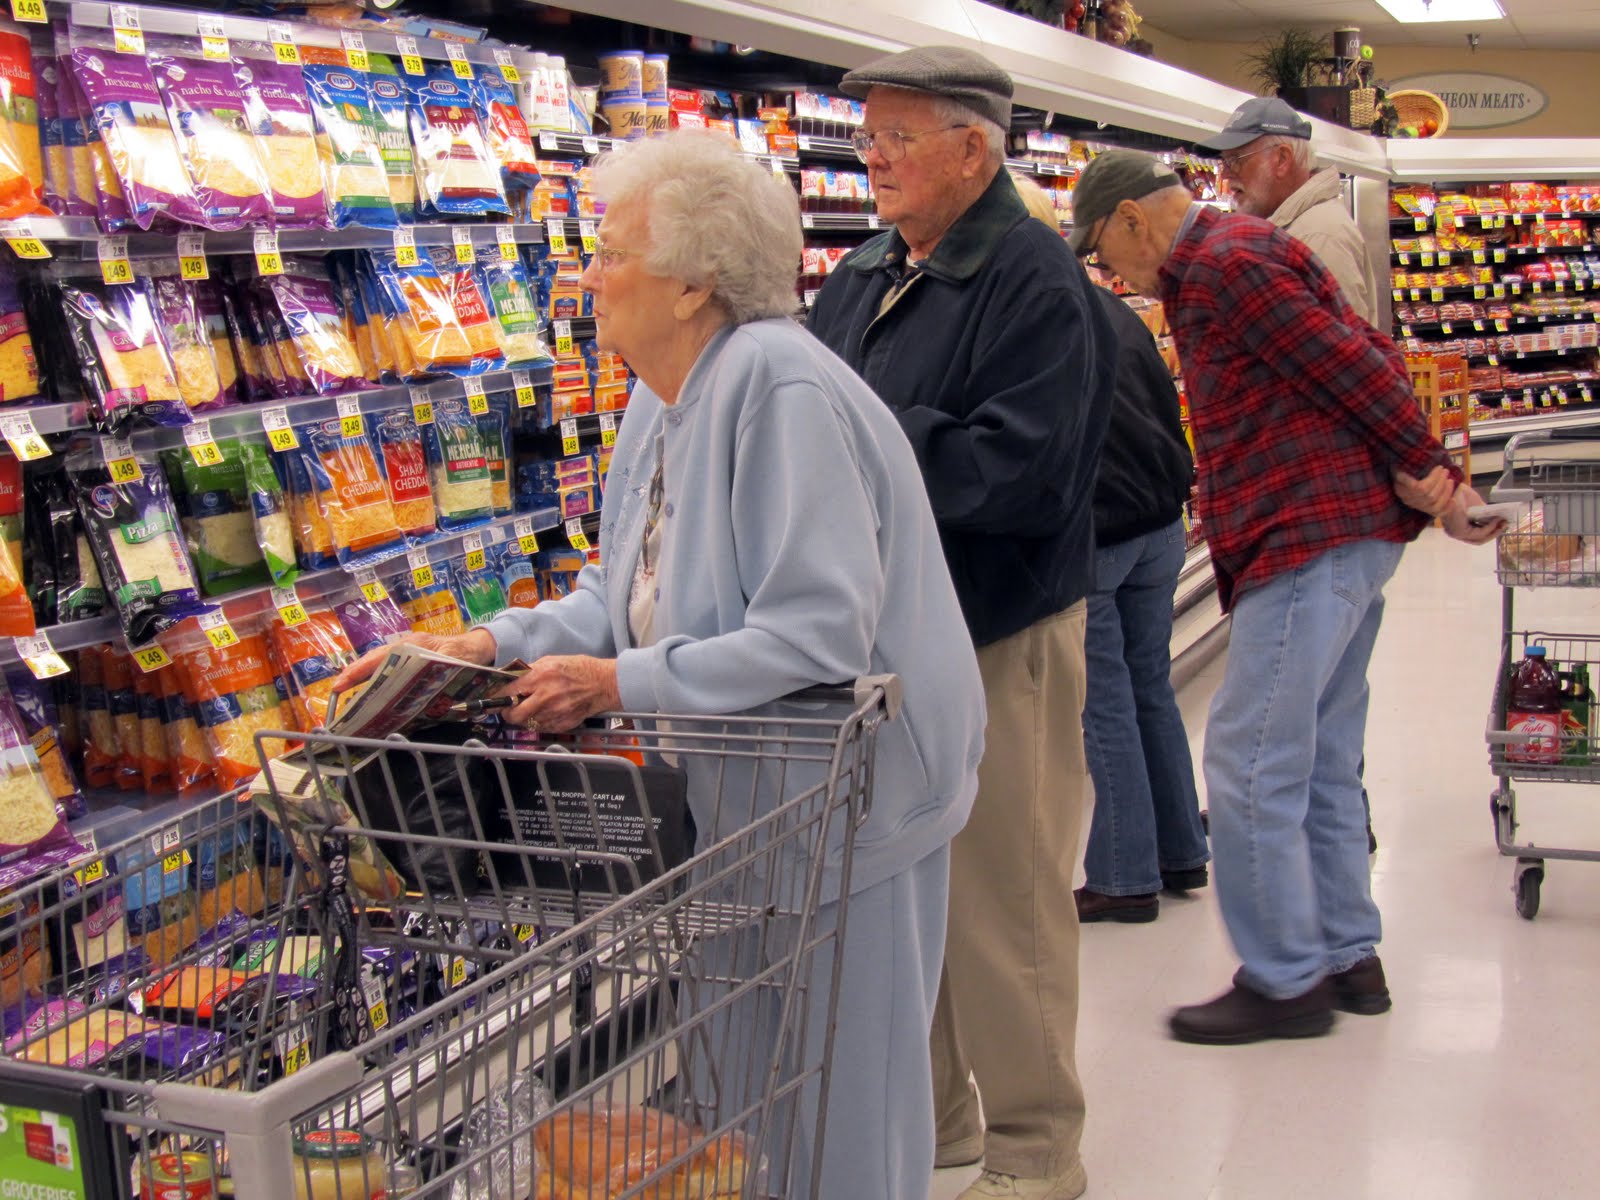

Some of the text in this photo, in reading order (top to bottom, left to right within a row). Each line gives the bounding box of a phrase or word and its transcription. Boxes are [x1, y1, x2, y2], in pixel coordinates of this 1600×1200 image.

[19, 2, 41, 15] 4.49
[279, 48, 296, 59] 4.49
[350, 54, 366, 66] 5.79
[405, 59, 421, 71] 5.79
[455, 64, 469, 75] 3.49
[0, 64, 31, 80] heddar
[505, 69, 518, 79] 3.49
[104, 78, 142, 89] mexican
[180, 83, 212, 96] nacho
[212, 84, 223, 97] &
[434, 83, 454, 92] KRAFT
[1436, 92, 1524, 109] HEON MEATS
[16, 243, 40, 253] 1.49
[552, 239, 564, 249] 3.49
[400, 250, 414, 261] 3.49
[458, 249, 472, 259] 3.49
[185, 261, 202, 274] 1.49
[262, 257, 278, 270] 1.49
[107, 264, 126, 278] 1.49
[455, 293, 473, 307] ARP
[457, 302, 484, 319] DDAR
[559, 340, 570, 351] 3.49
[519, 391, 532, 402] 3.49
[471, 398, 485, 410] 3.49
[417, 408, 431, 420] 3.49
[344, 420, 360, 433] 3.49
[273, 433, 291, 446] 1.49
[565, 440, 576, 450] 3.49
[196, 447, 215, 460] 1.49
[447, 442, 481, 460] MEXICAN
[115, 463, 135, 477] 1.49
[399, 464, 424, 477] SHARP
[455, 460, 479, 469] AUTHENTIC
[342, 481, 382, 498] CHEDDAR
[127, 521, 158, 540] Pizza
[522, 539, 535, 551] 3.49
[572, 537, 586, 548] 3.49
[469, 554, 482, 567] 3.49
[416, 571, 431, 583] 3.49
[284, 608, 302, 622] 1.49
[422, 614, 452, 631] TRIPLE
[212, 629, 231, 643] 1.49
[141, 650, 162, 666] 1.49
[206, 668, 235, 681] marble
[1521, 722, 1547, 733] light
[628, 847, 653, 855] PREMIS
[85, 862, 98, 876] .49
[2, 1179, 76, 1200] GROCERIES
